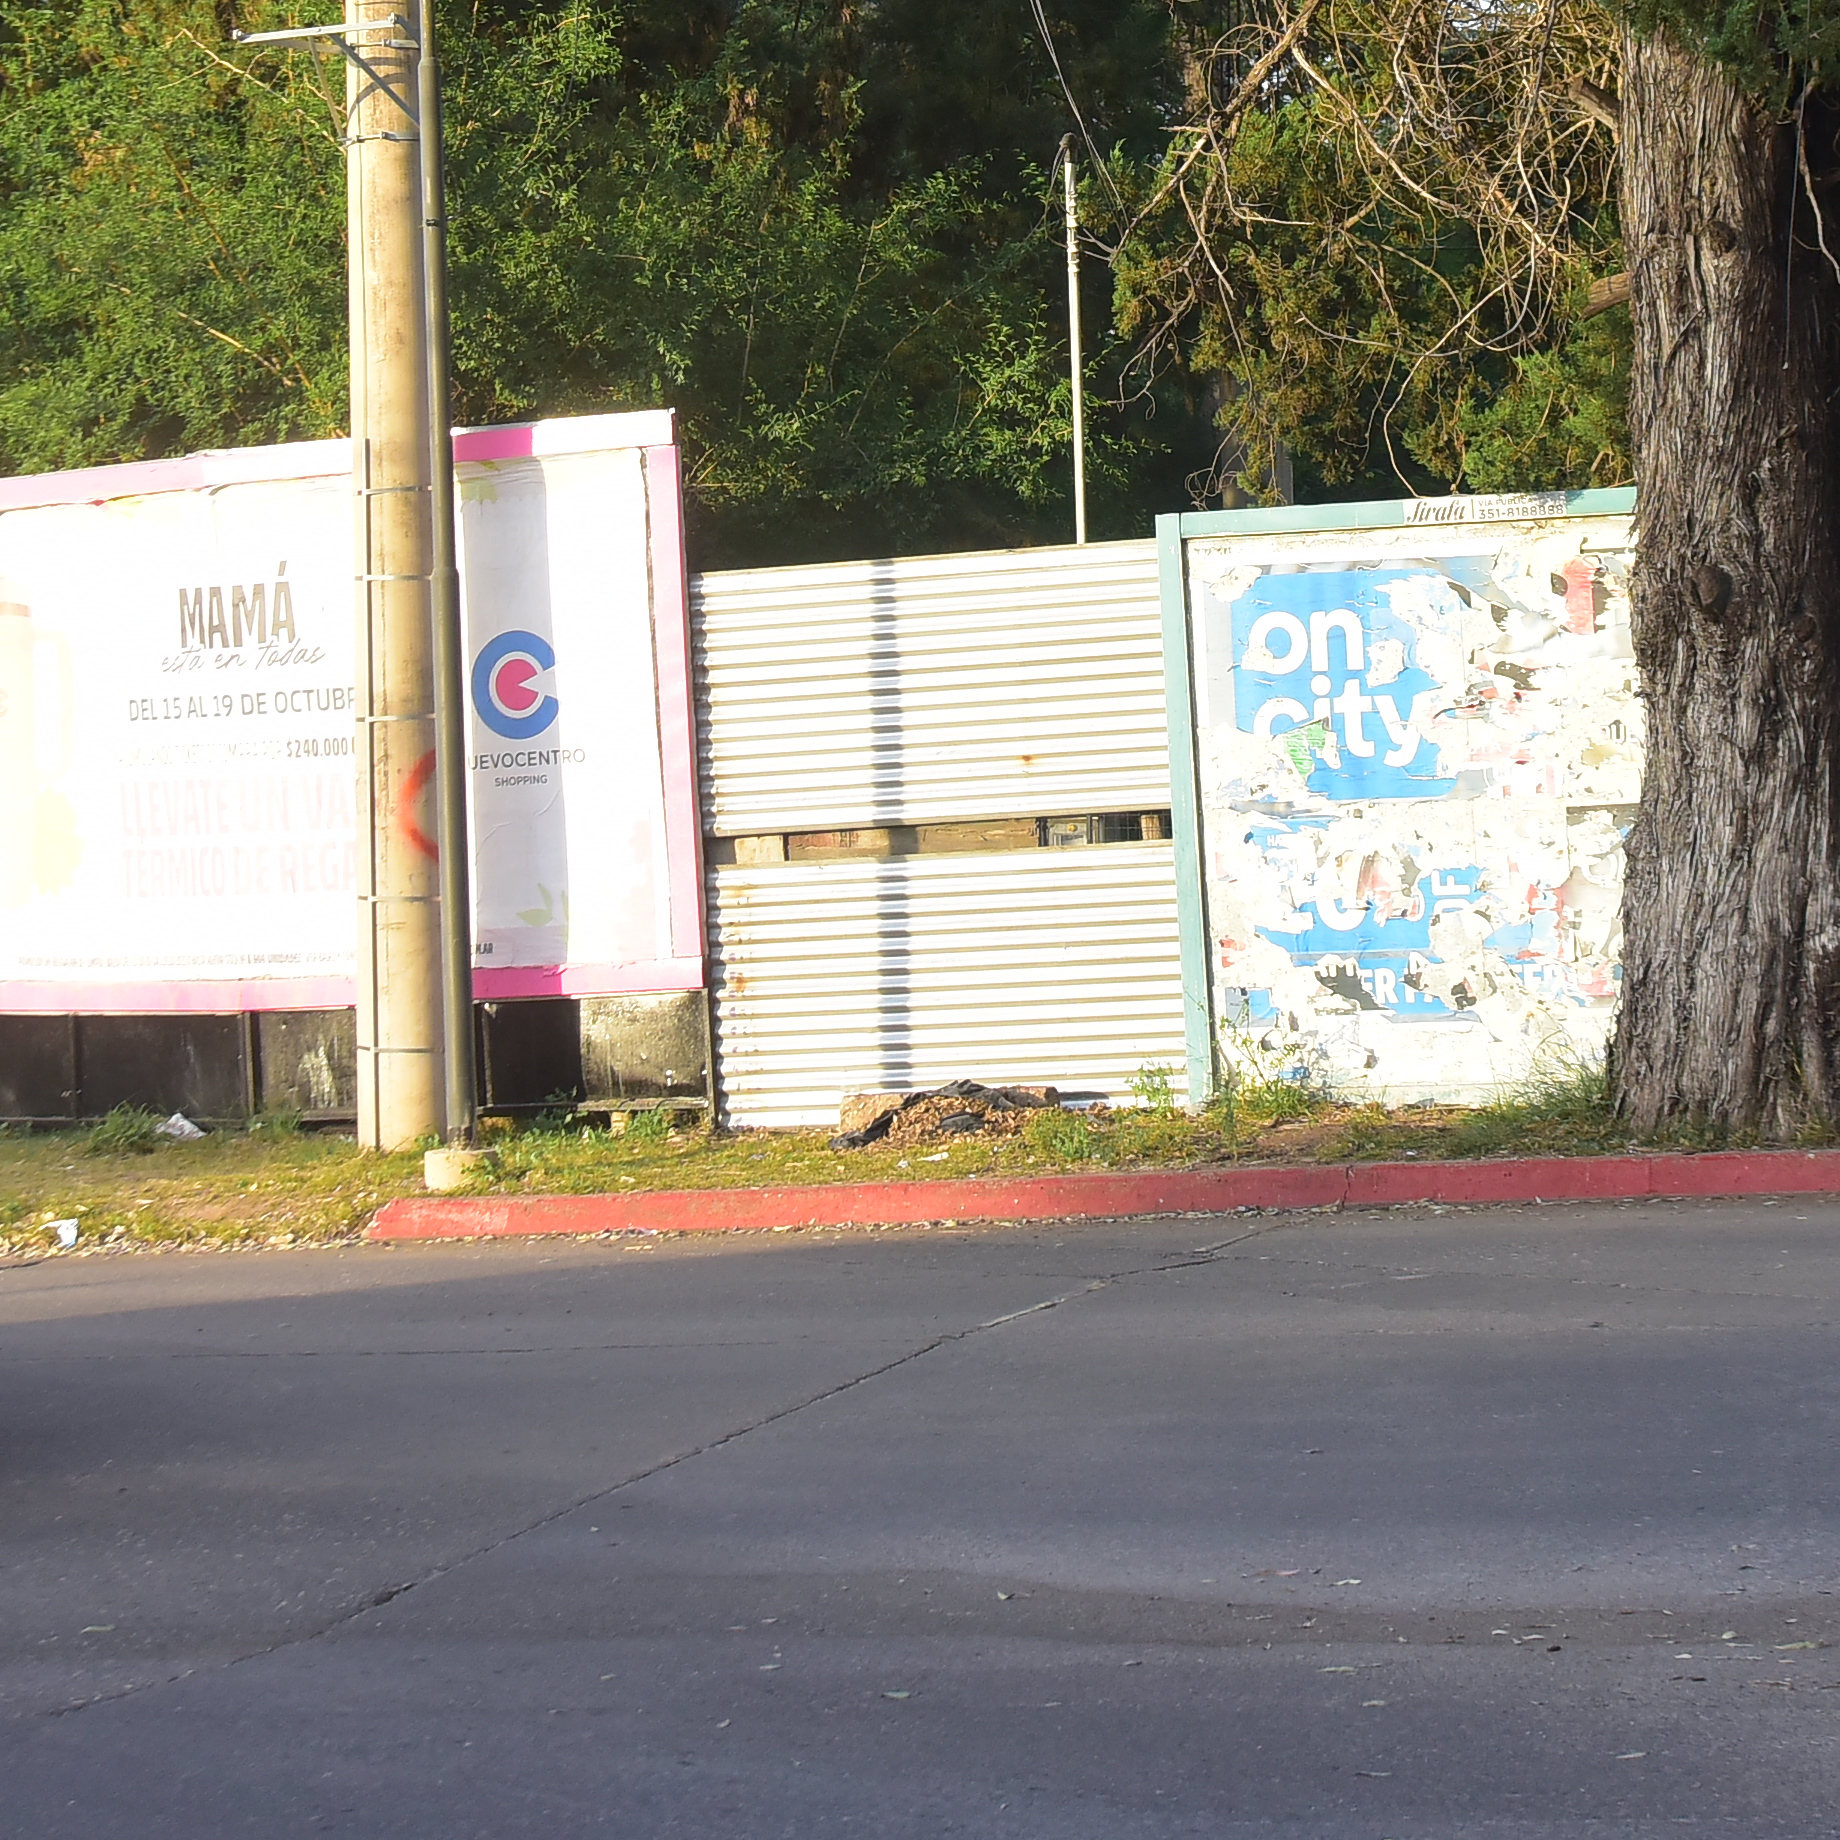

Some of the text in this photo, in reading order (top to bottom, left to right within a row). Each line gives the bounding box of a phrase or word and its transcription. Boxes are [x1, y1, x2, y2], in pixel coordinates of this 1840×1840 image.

[1478, 504, 1564, 520] 351-8188888
[178, 560, 296, 649] MAMÁ
[215, 653, 247, 670] en
[255, 638, 326, 670] todas
[1243, 607, 1366, 676] on
[129, 686, 355, 722] DEL 15 AL 19 DE OCTUBR
[286, 736, 349, 759] $240.000
[468, 748, 586, 771] UEVOCENTRO
[494, 774, 549, 788] SHOPPING
